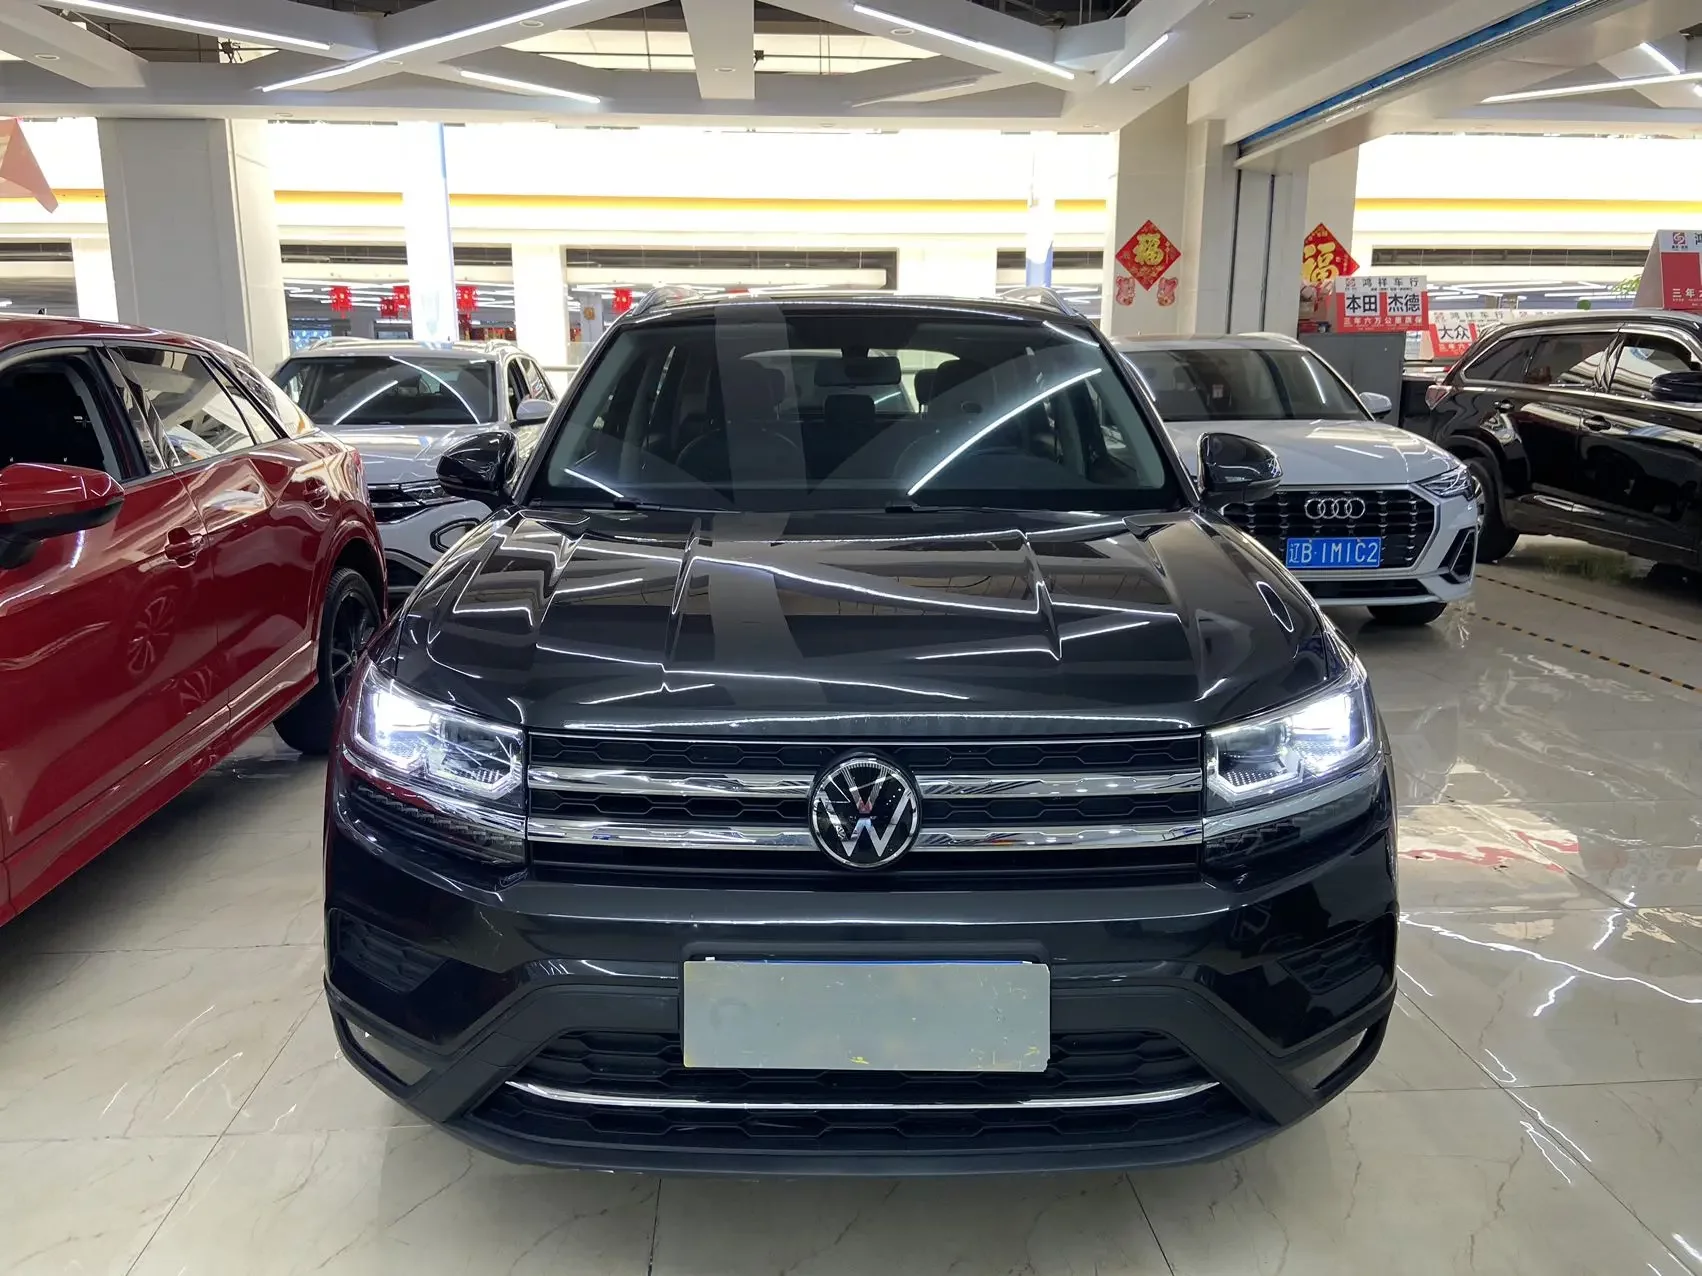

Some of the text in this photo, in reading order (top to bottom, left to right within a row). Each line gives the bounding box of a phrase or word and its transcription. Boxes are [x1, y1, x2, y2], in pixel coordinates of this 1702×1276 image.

[1132, 232, 1164, 266] 福
[1672, 288, 1702, 298] 三年
[1346, 293, 1420, 313] 本田 杰德
[1439, 325, 1470, 339] 大众
